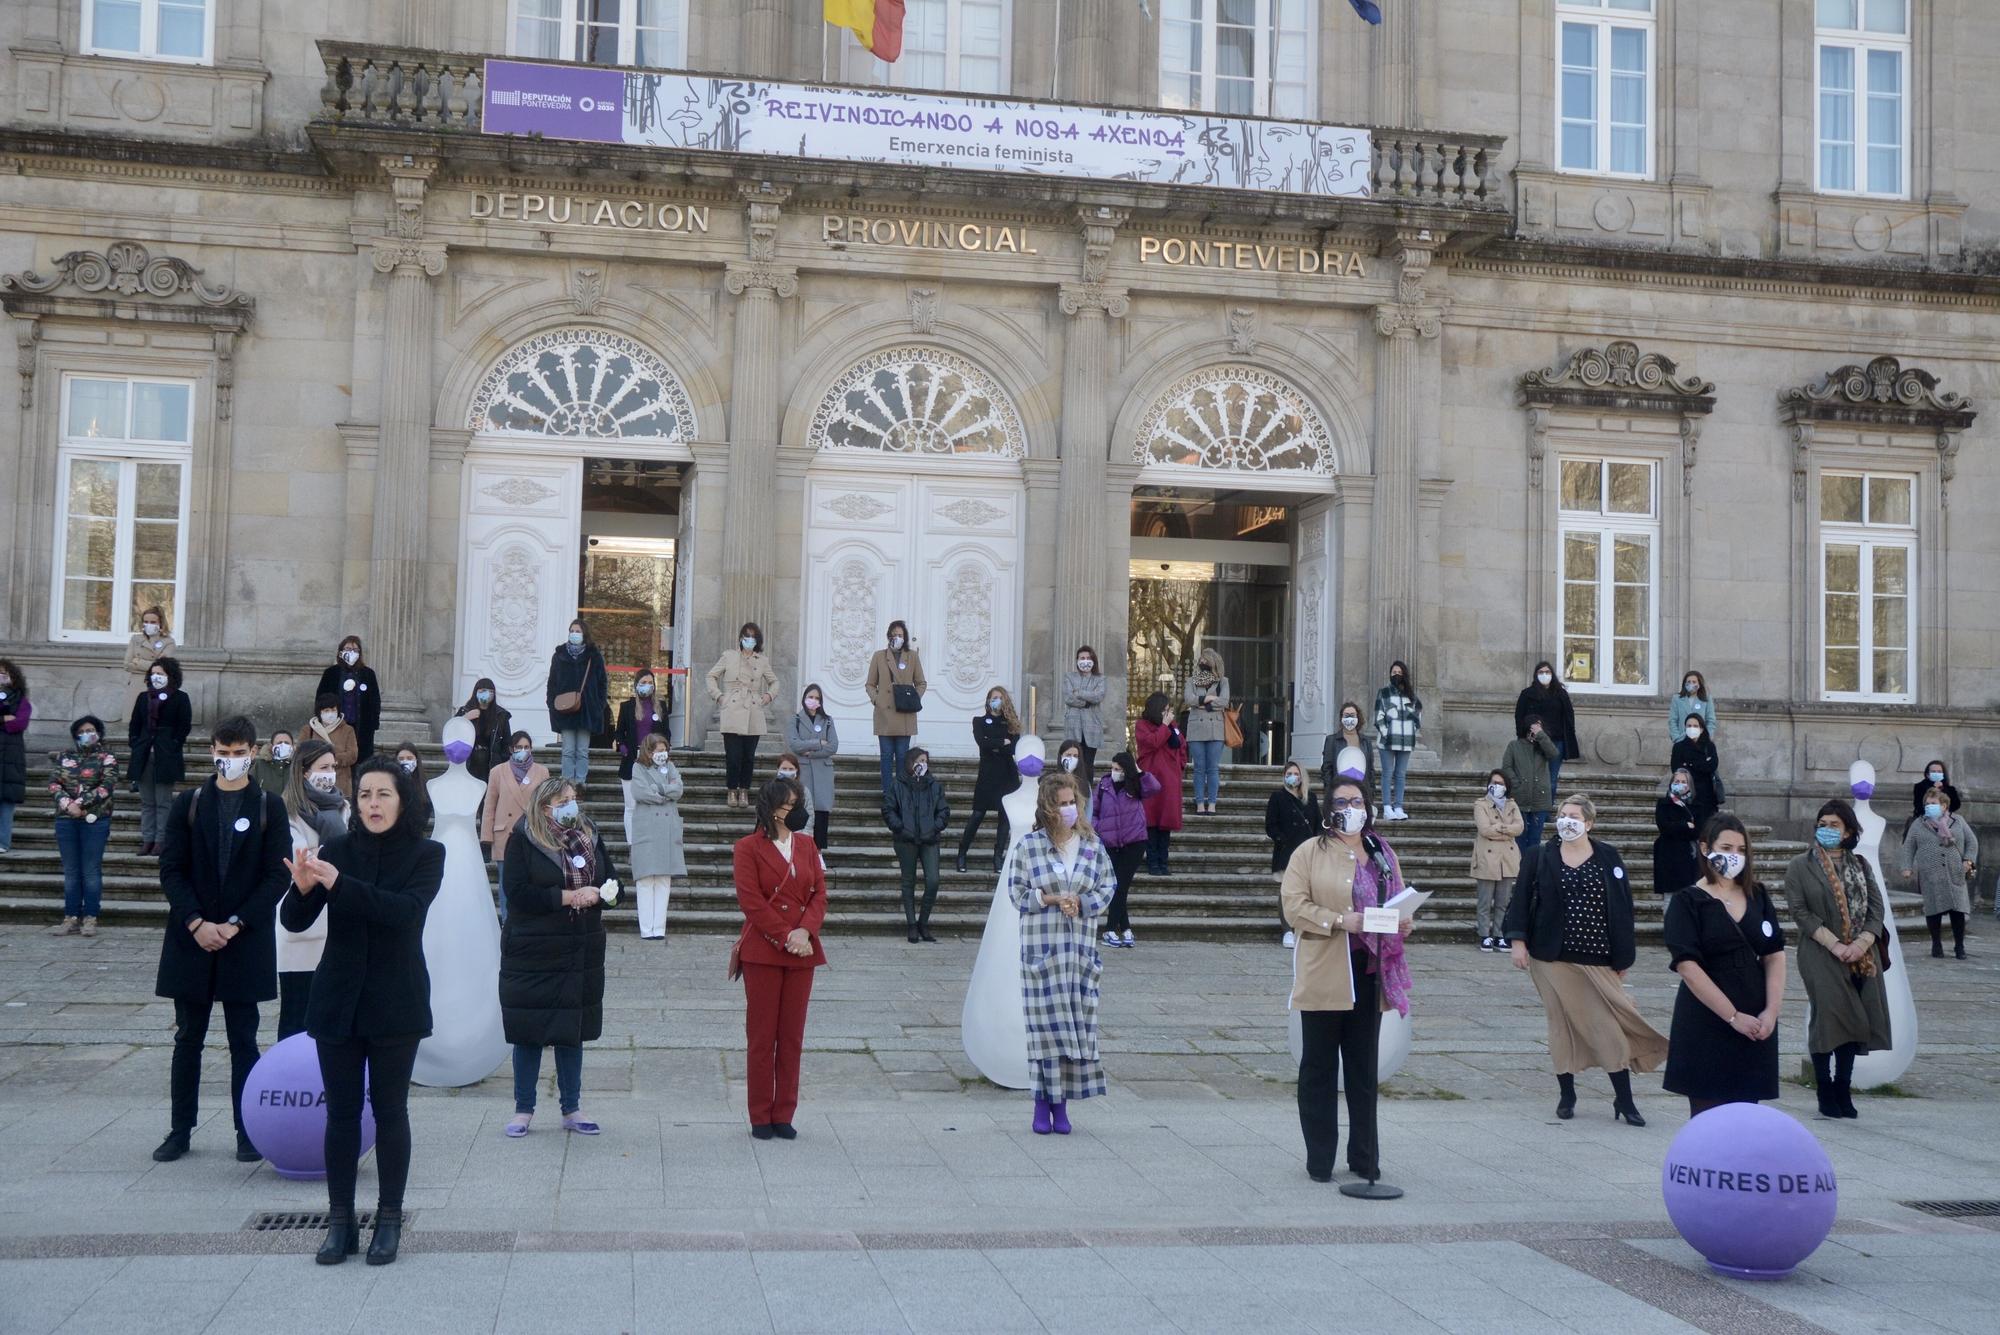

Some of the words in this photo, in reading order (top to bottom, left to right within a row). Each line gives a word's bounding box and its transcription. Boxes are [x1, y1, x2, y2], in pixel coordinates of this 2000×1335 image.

[522, 92, 572, 103] DEPUTACIÓN
[522, 100, 572, 110] PONTEVEDRA
[764, 98, 973, 133] REIVINDICANDO
[983, 116, 1004, 136] A
[1015, 118, 1081, 142] NOSA
[1088, 121, 1186, 149] AXENDA
[889, 137, 991, 159] Emerxencia
[995, 146, 1074, 164] feminista
[470, 191, 711, 233] DEPUTACION
[822, 214, 1038, 255] PROVINCIAL
[1140, 235, 1367, 278] PONTEVEDRA
[1669, 1163, 1771, 1194] VENTRES
[1778, 1174, 1810, 1195] DE
